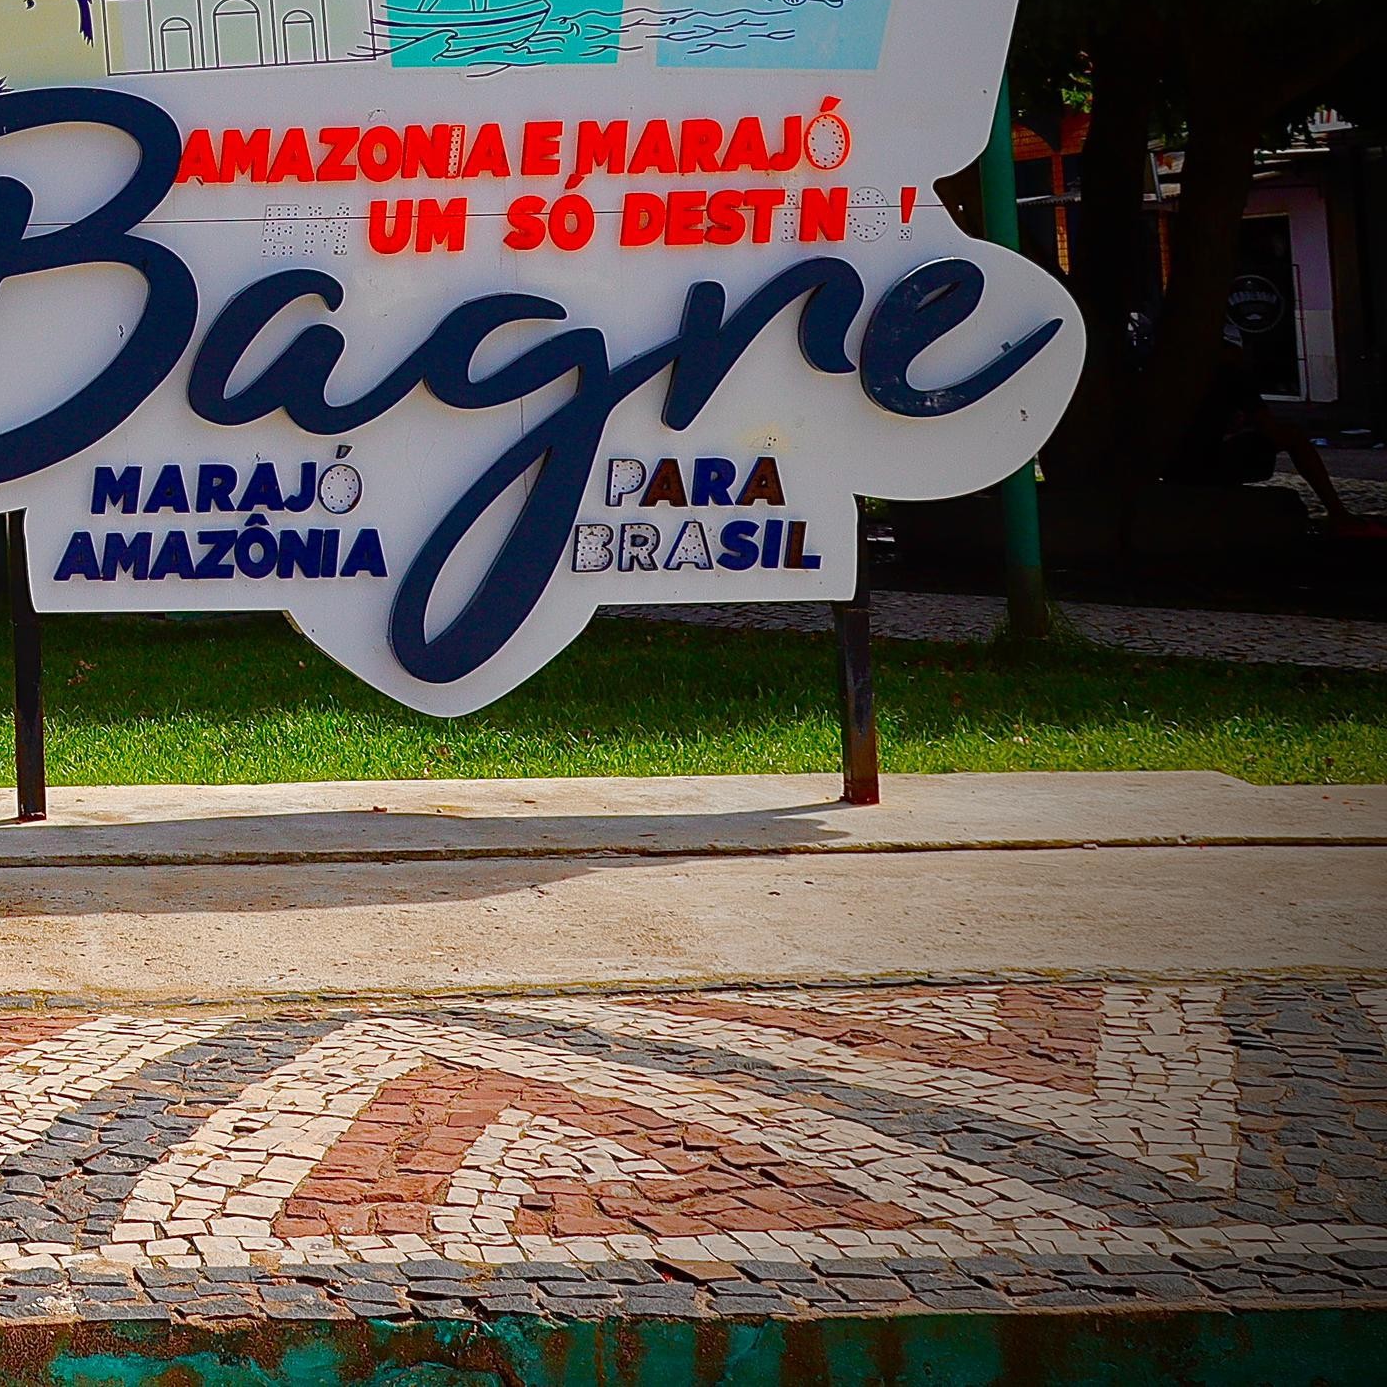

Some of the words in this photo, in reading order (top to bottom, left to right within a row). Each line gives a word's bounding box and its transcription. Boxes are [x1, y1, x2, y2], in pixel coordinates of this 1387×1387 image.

[520, 120, 564, 177] E
[575, 95, 851, 175] MARAJÓ
[367, 197, 468, 255] UM
[503, 173, 595, 252] SÓ
[90, 443, 364, 515] MARAJÓ
[52, 513, 390, 582] AMAZÔNIA
[571, 519, 823, 573] BRASIL
